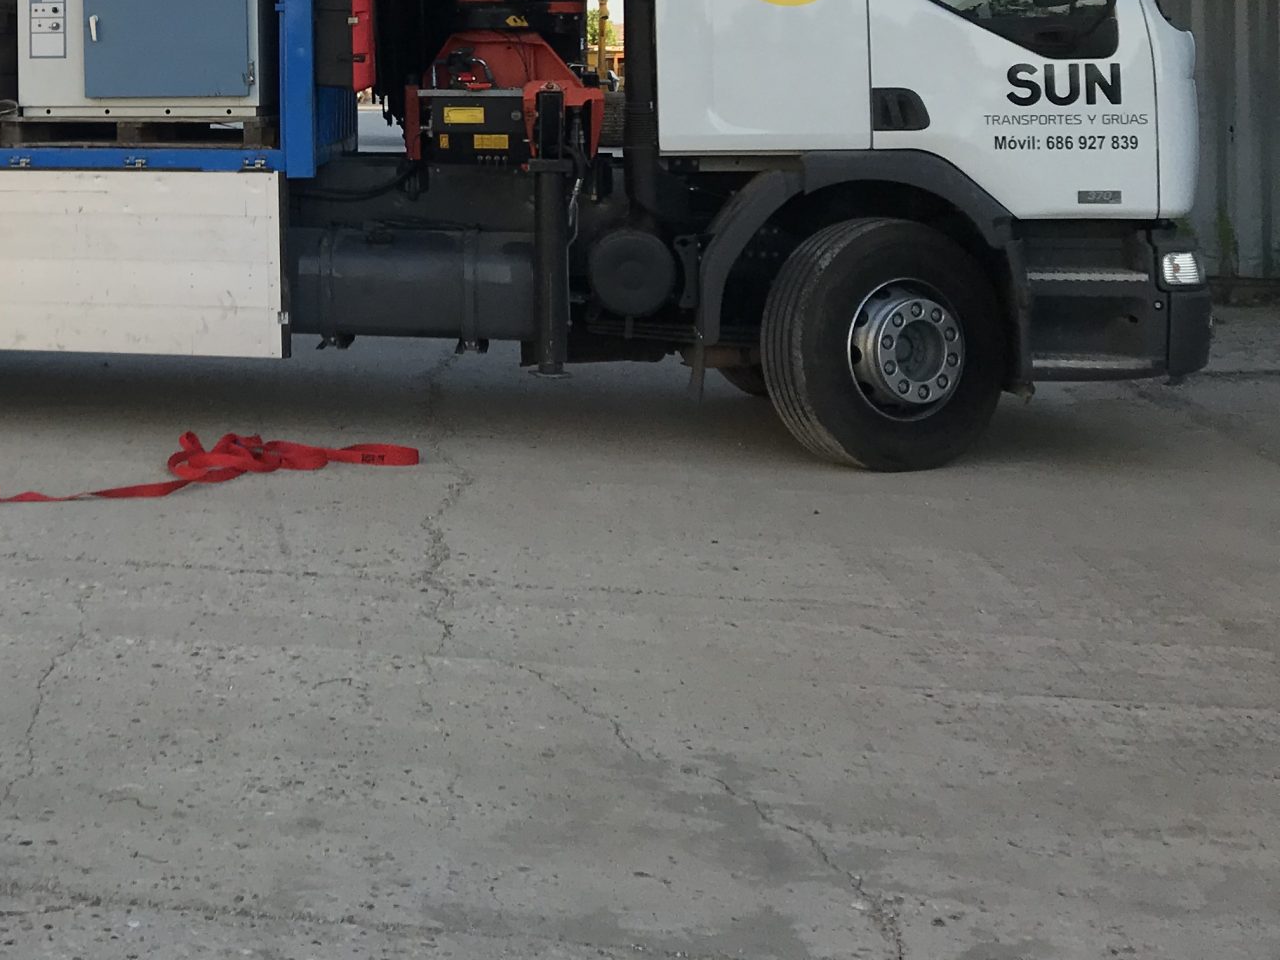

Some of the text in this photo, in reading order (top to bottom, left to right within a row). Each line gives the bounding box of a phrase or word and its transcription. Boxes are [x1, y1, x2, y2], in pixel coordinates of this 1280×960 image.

[1006, 63, 1122, 106] SUN
[984, 112, 1149, 126] TRANSPORTES Y GRÚAS
[994, 135, 1139, 150] Móvil: 686 927 839
